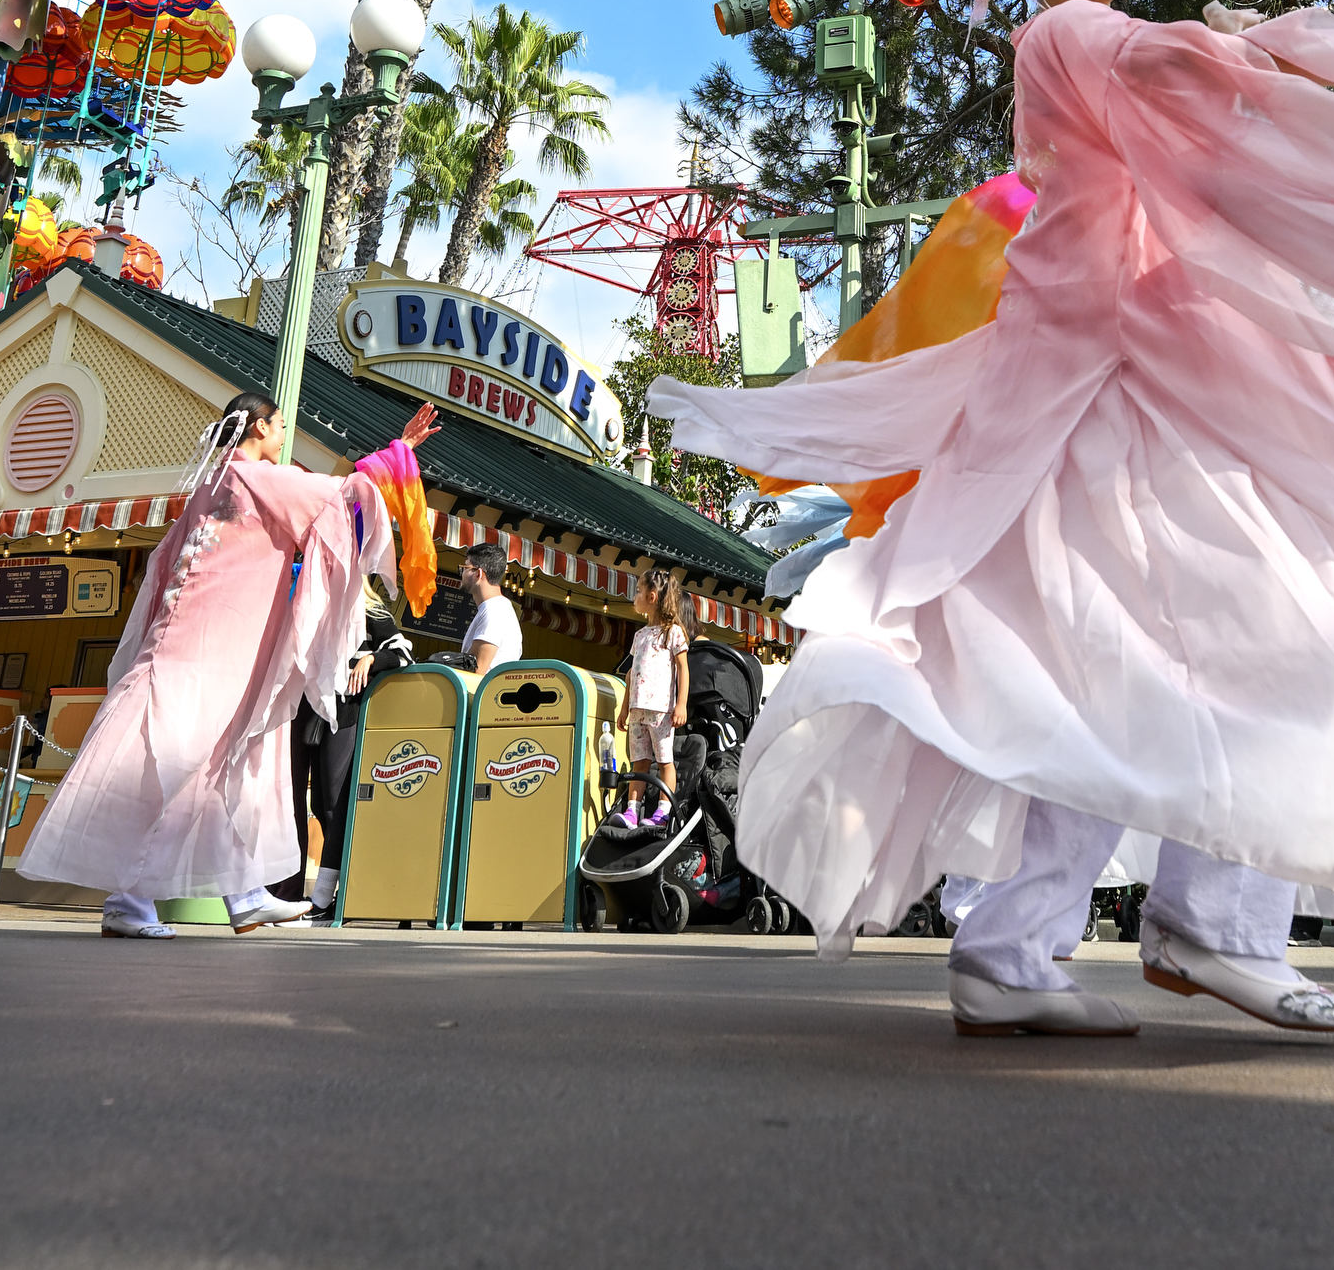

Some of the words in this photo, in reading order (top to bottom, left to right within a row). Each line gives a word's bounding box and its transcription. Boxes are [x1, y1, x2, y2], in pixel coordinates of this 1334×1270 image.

[396, 294, 596, 422] BAYSIDE
[448, 366, 537, 427] BREWS
[24, 557, 51, 567] BREWS
[436, 576, 462, 588] AYSIDE
[374, 767, 399, 779] PARADISE
[400, 759, 424, 775] GARDENS
[424, 758, 438, 770] PARK
[489, 765, 515, 777] PARADISE
[516, 759, 541, 774] GARDENS
[542, 759, 557, 770] PARK
